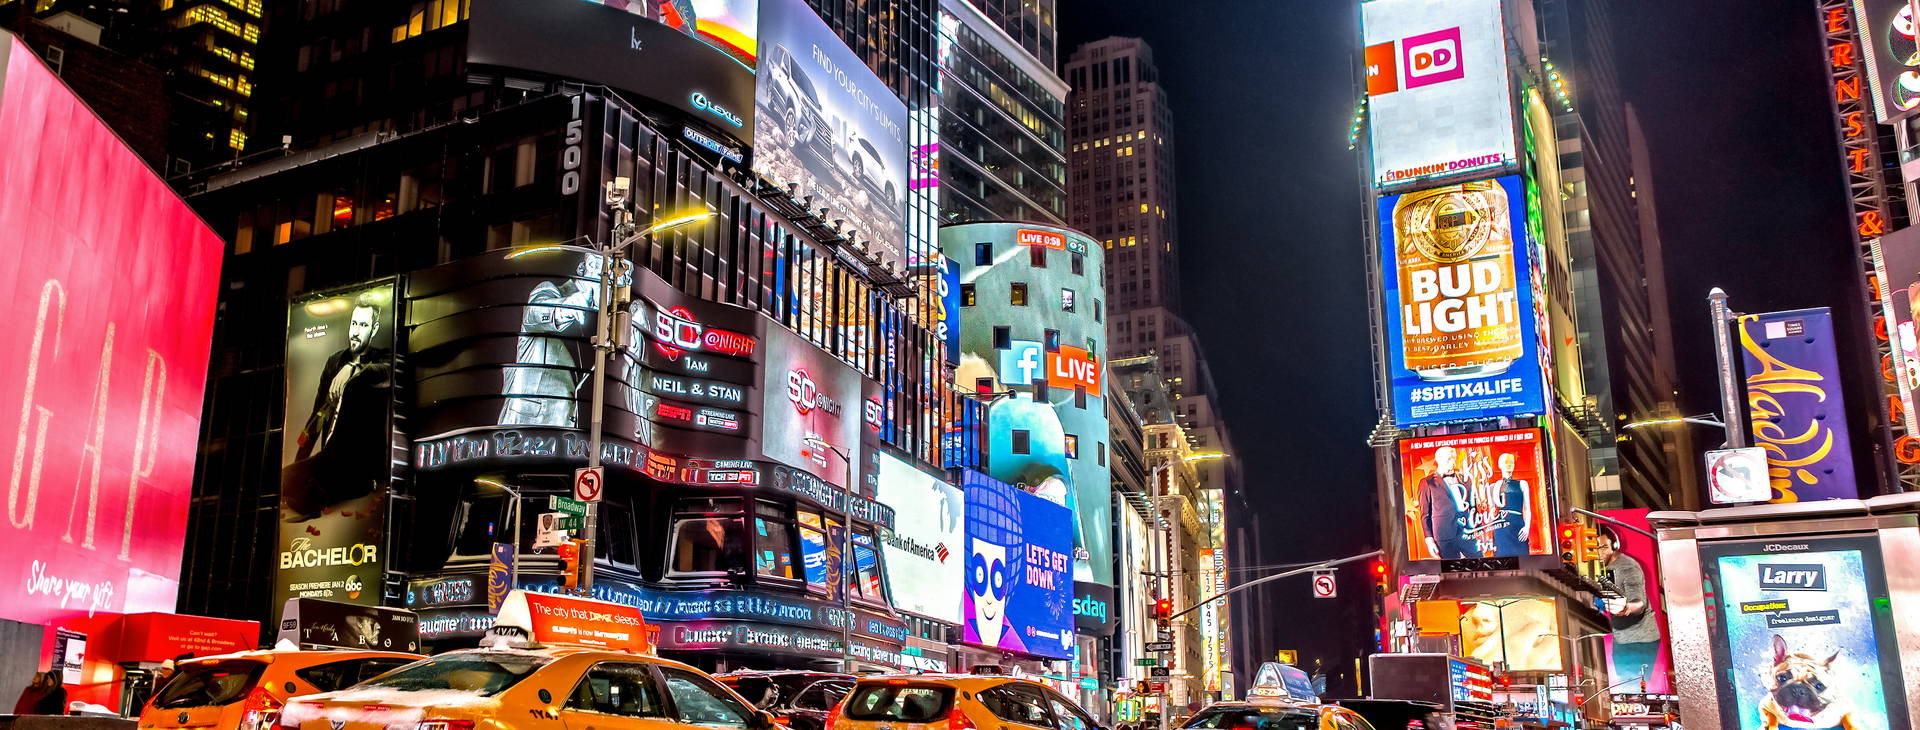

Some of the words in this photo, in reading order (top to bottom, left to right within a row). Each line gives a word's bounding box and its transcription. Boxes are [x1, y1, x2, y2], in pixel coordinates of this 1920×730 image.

[813, 43, 833, 74] FIND
[833, 63, 857, 99] YOUR
[1415, 48, 1451, 71] DD
[1829, 9, 1868, 173] ERNST
[707, 101, 743, 128] LEXUS
[562, 96, 582, 195] 1500
[1395, 162, 1448, 179] DUNKIN'
[1448, 153, 1501, 170] DONUTS
[1859, 210, 1883, 236] &
[1022, 233, 1042, 243] LIVE
[1411, 260, 1501, 302] BUD
[1404, 291, 1515, 335] LIGHT
[656, 312, 702, 348] SC
[704, 331, 757, 354] @NIGHT
[684, 356, 708, 371] 1AM
[1056, 356, 1095, 384] LIVE
[652, 377, 686, 393] NEIL
[691, 383, 704, 395] &
[708, 386, 741, 402] STAN
[787, 370, 816, 409] SC
[1410, 378, 1523, 403] #SBTIX4LIFE
[8, 279, 166, 561] GAP
[657, 403, 691, 421] ESPN
[557, 498, 585, 517] Broadway
[1452, 482, 1506, 512] BANG
[568, 518, 577, 528] 44
[280, 544, 377, 569] BACHELOR
[290, 537, 312, 553] The
[904, 536, 910, 552] of
[910, 538, 935, 561] America
[1763, 544, 1809, 552] JCDecaux
[1026, 543, 1050, 568] LET'S
[1052, 551, 1068, 574] GET
[27, 560, 62, 597] Share
[60, 579, 91, 608] your
[89, 577, 115, 618] gift
[290, 583, 309, 591] SEASON
[344, 580, 362, 592] abc
[1026, 564, 1056, 590] DOWN.
[1763, 567, 1818, 587] Larry
[300, 590, 323, 598] MONDAYS
[533, 602, 551, 615] The
[553, 605, 569, 618] city
[570, 608, 588, 621] that
[614, 613, 641, 627] sleeps.
[1073, 594, 1106, 624] sdaq
[1743, 602, 1787, 612] Occupation:
[1771, 617, 1804, 625] freelance
[1804, 614, 1835, 623] designer
